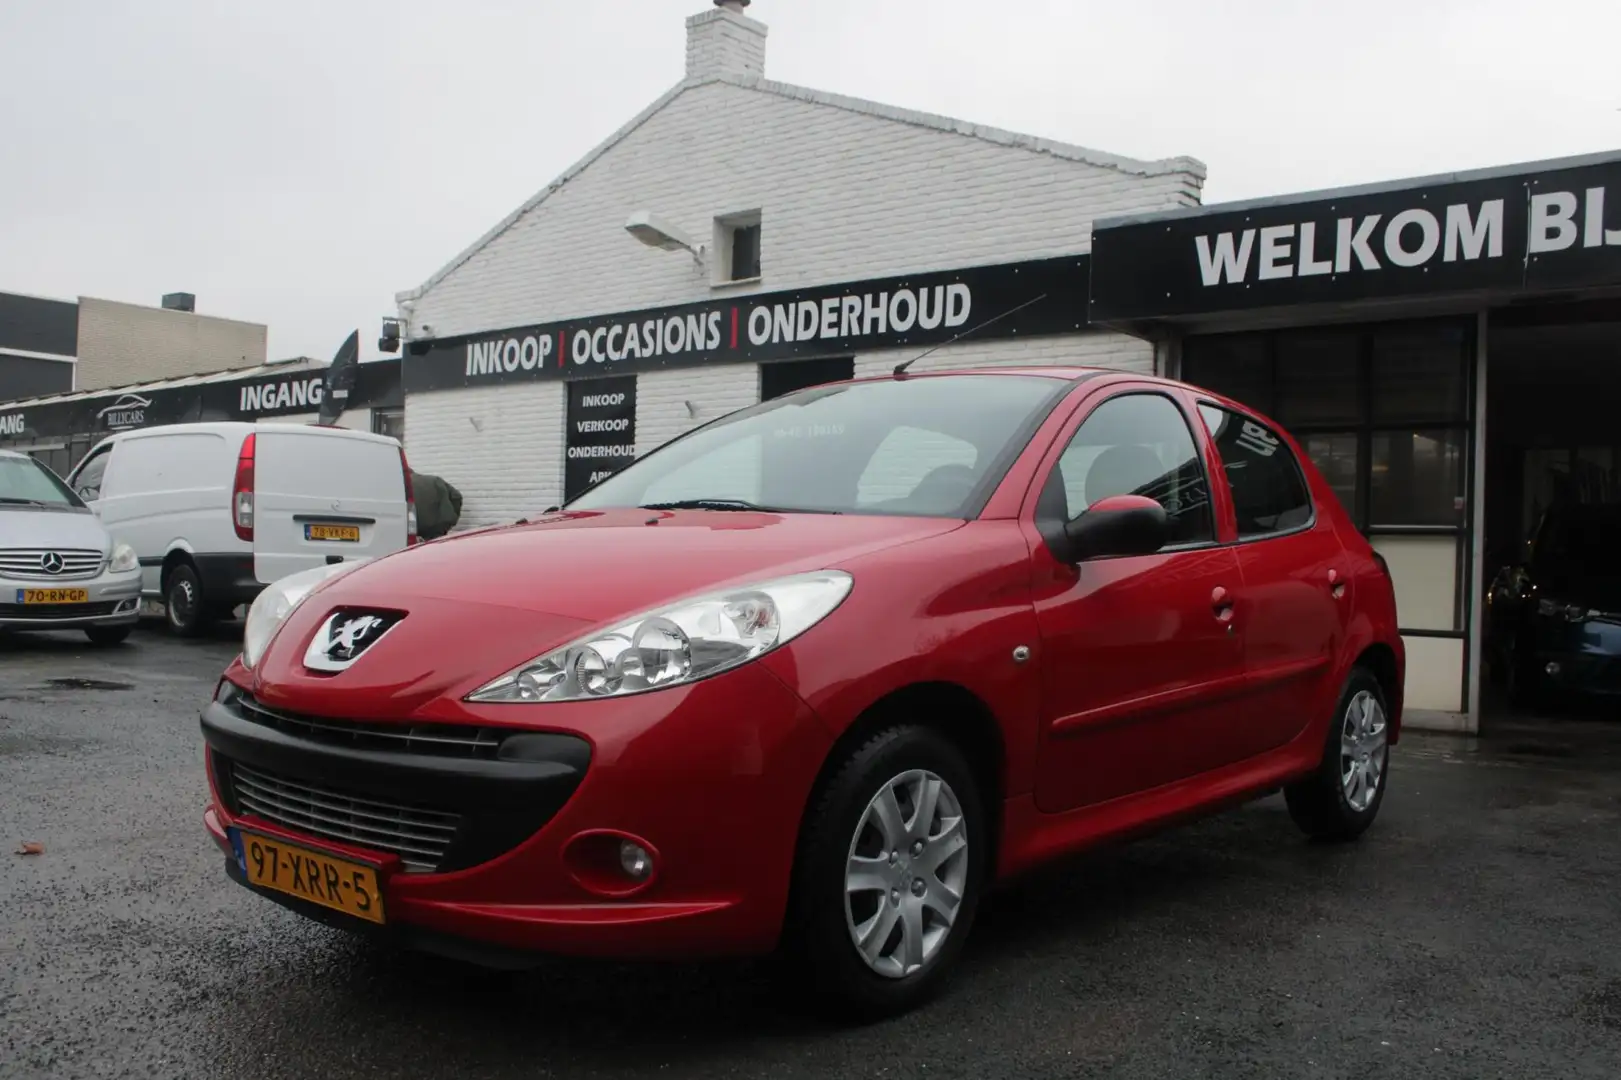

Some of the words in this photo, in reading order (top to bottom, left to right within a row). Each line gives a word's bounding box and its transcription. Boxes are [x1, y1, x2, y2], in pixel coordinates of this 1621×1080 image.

[1195, 199, 1505, 287] WELKOM
[466, 334, 552, 376] INKOOP
[572, 311, 721, 365] OCCASIONS
[748, 283, 972, 346] ONDERHOUD
[240, 378, 323, 411] INGANG
[582, 393, 625, 407] INKOOP
[107, 410, 145, 426] BILLYCARS
[577, 418, 629, 433] VERKOOP
[567, 444, 636, 458] ONDERHOUD
[27, 589, 85, 602] 70-RN-GP
[251, 841, 371, 911] 97-XRR-5
